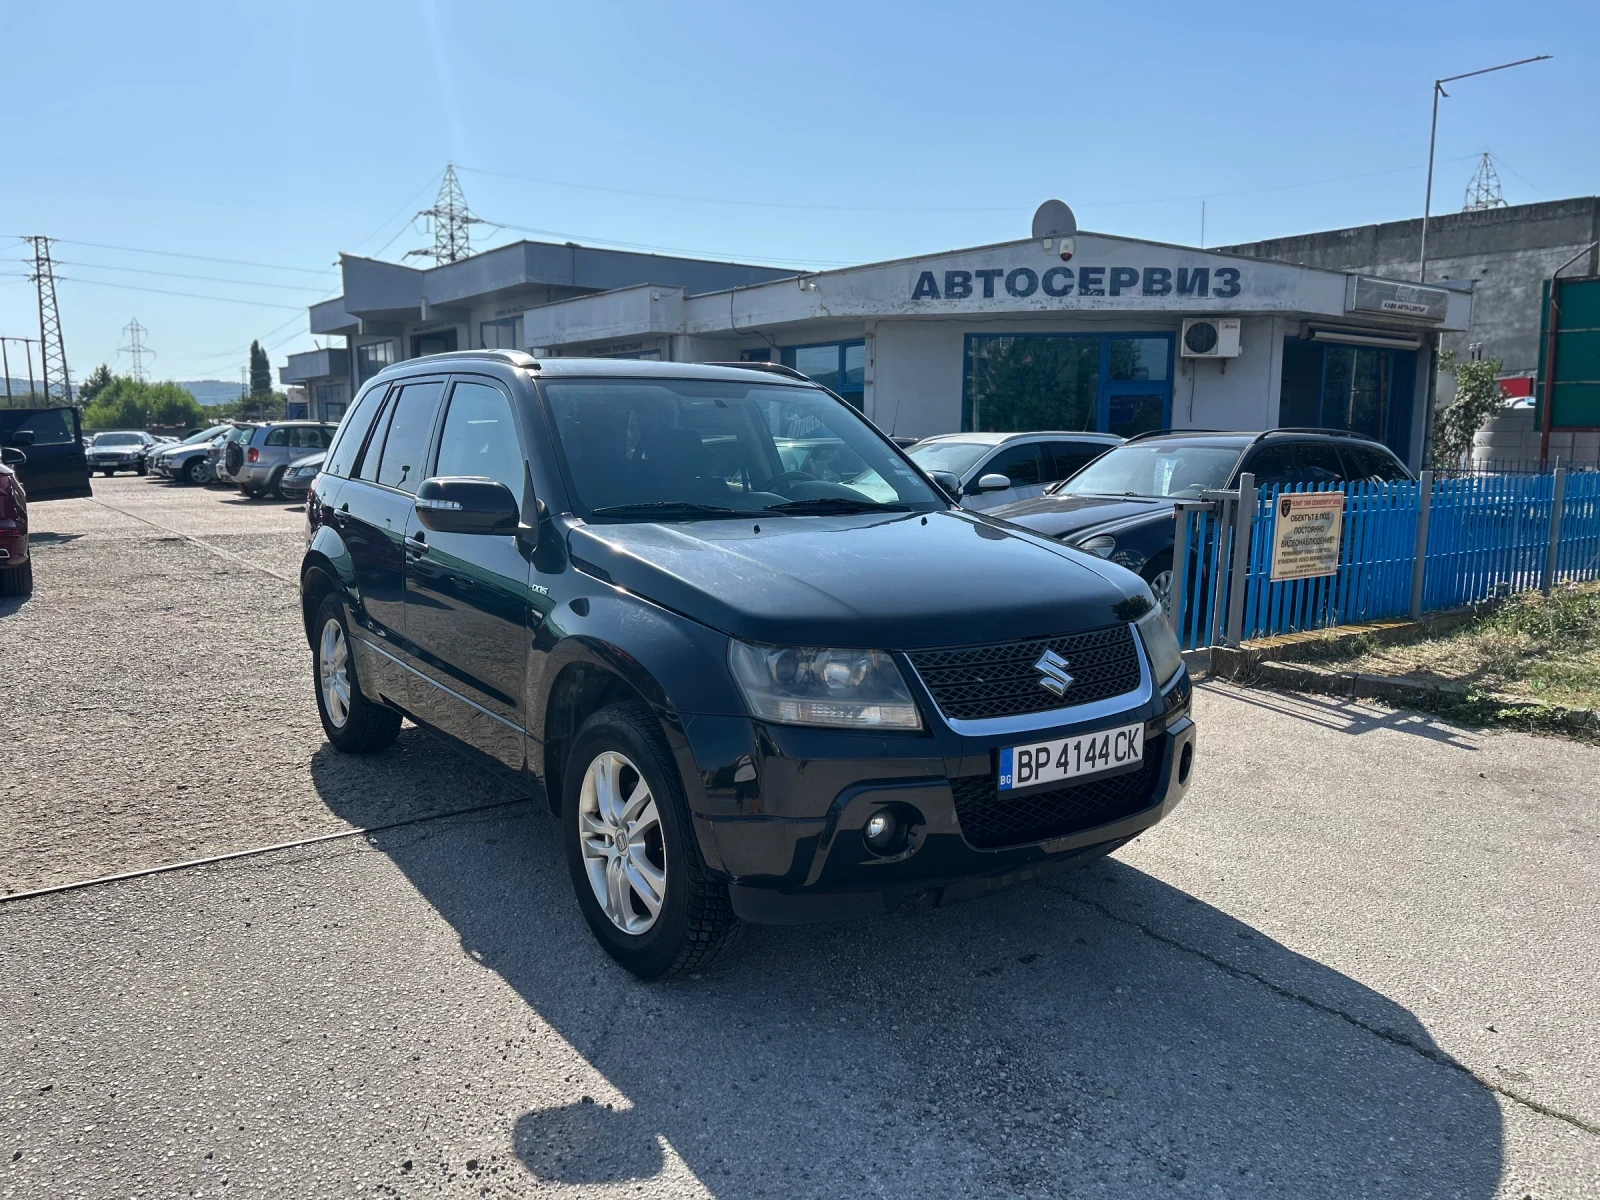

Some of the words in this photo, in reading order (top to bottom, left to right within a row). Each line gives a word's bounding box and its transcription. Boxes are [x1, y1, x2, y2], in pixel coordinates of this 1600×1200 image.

[911, 267, 1241, 300] АВТОСЕРВИЗ
[1291, 514, 1314, 522] ОБЕКТЪТ
[1315, 513, 1319, 521] Е
[1319, 512, 1330, 521] ПОД
[1294, 525, 1325, 534] ПОСТОЯННО
[1281, 536, 1335, 548] ВИДЕОНАБЛЮДЕНИЕ!
[1018, 746, 1050, 783] BP
[1056, 734, 1110, 774] 4144
[1115, 727, 1140, 762] CK
[1000, 775, 1012, 785] BG
